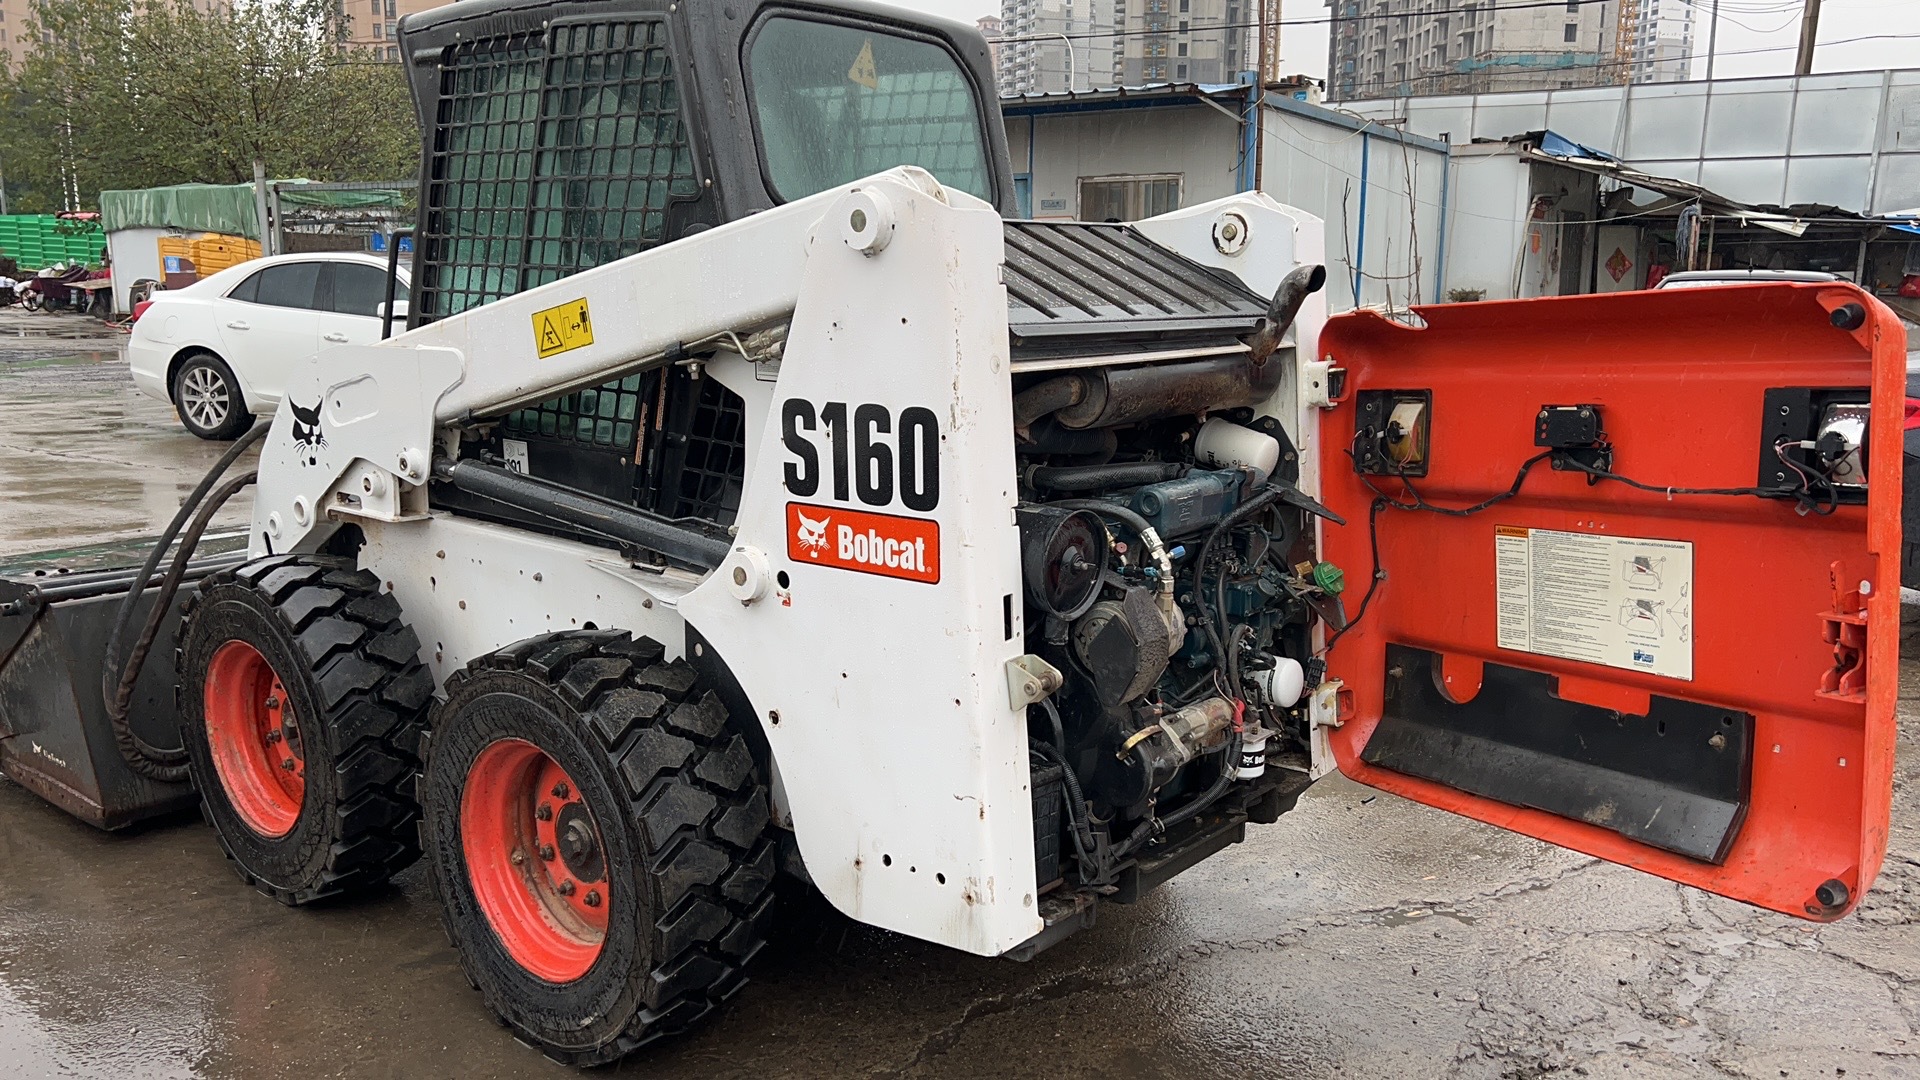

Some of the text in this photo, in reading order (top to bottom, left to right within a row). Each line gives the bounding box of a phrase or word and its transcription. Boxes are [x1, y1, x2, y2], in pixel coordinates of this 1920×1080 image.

[782, 398, 939, 512] S160
[837, 524, 926, 573] Bobcat
[1502, 528, 1527, 536] WARNING
